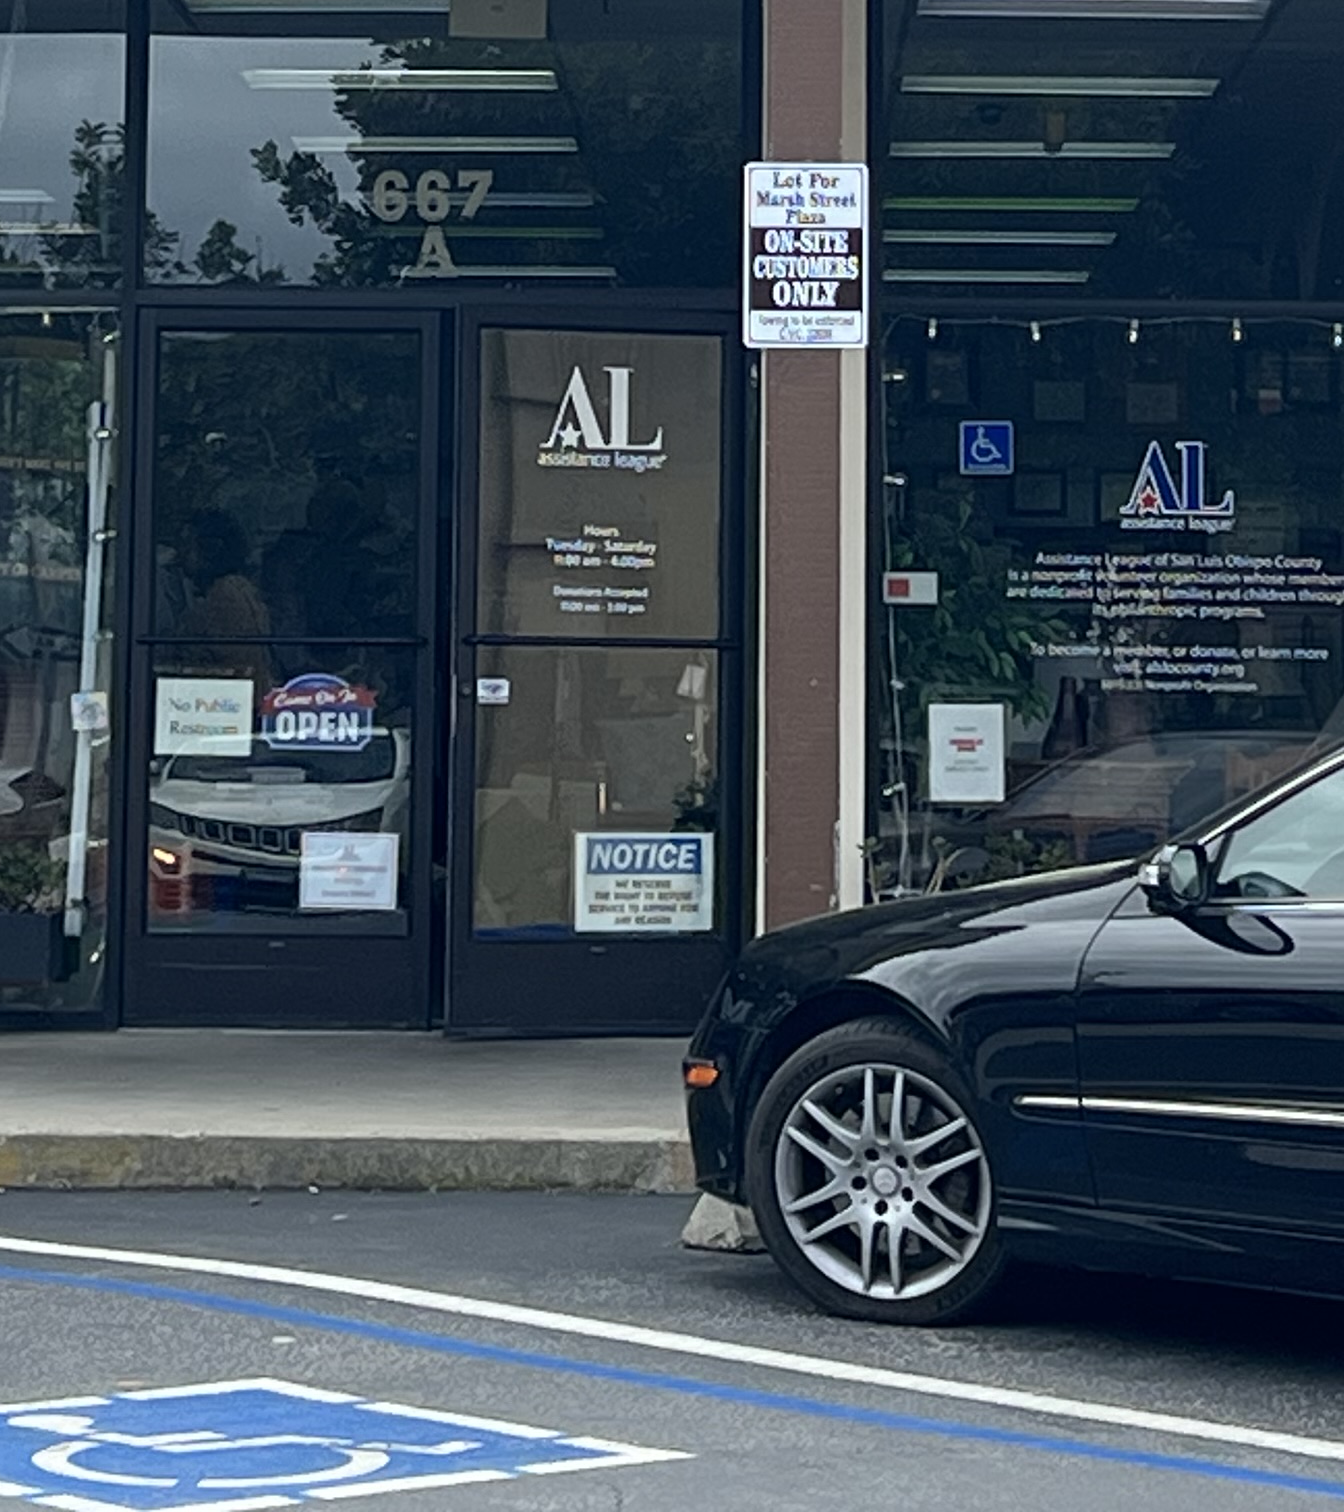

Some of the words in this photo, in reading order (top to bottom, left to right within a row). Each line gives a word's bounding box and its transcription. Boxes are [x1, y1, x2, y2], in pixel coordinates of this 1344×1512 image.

[773, 172, 801, 189] Lot
[809, 173, 840, 189] For
[372, 169, 494, 223] 667
[756, 191, 805, 207] Marsh
[809, 192, 857, 207] Street
[786, 209, 826, 224] Plaza
[764, 229, 849, 253] ON-SITE
[406, 225, 459, 278] A
[753, 254, 859, 280] CUSTOMERS
[772, 280, 840, 307] ONLY
[539, 366, 663, 450] AL
[537, 451, 611, 467] assistance
[1119, 440, 1234, 516] AL
[1120, 517, 1185, 530] assistance
[545, 537, 596, 554] Tuesday
[604, 539, 656, 556] Saturday
[1036, 552, 1102, 566] Assistance
[1154, 553, 1169, 566] of
[1197, 555, 1223, 567] Luis
[1225, 555, 1273, 569] Obispo
[1274, 555, 1323, 571] County
[1158, 571, 1241, 586] organization
[1243, 573, 1286, 584] whose
[1006, 587, 1027, 598] are
[1030, 586, 1094, 599] dedicated
[1163, 587, 1213, 600] families
[1215, 589, 1240, 601] and
[1243, 588, 1296, 601] children
[1030, 642, 1045, 656] To
[1047, 643, 1101, 656] become
[1172, 647, 1187, 658] or
[1241, 648, 1256, 659] or
[1258, 645, 1292, 659] learn
[1293, 649, 1329, 660] more
[169, 697, 191, 713] No
[194, 697, 241, 713] Public
[273, 692, 312, 708] Come
[315, 690, 335, 704] On
[275, 711, 360, 742] OPEN
[590, 842, 698, 871] NOTICE
